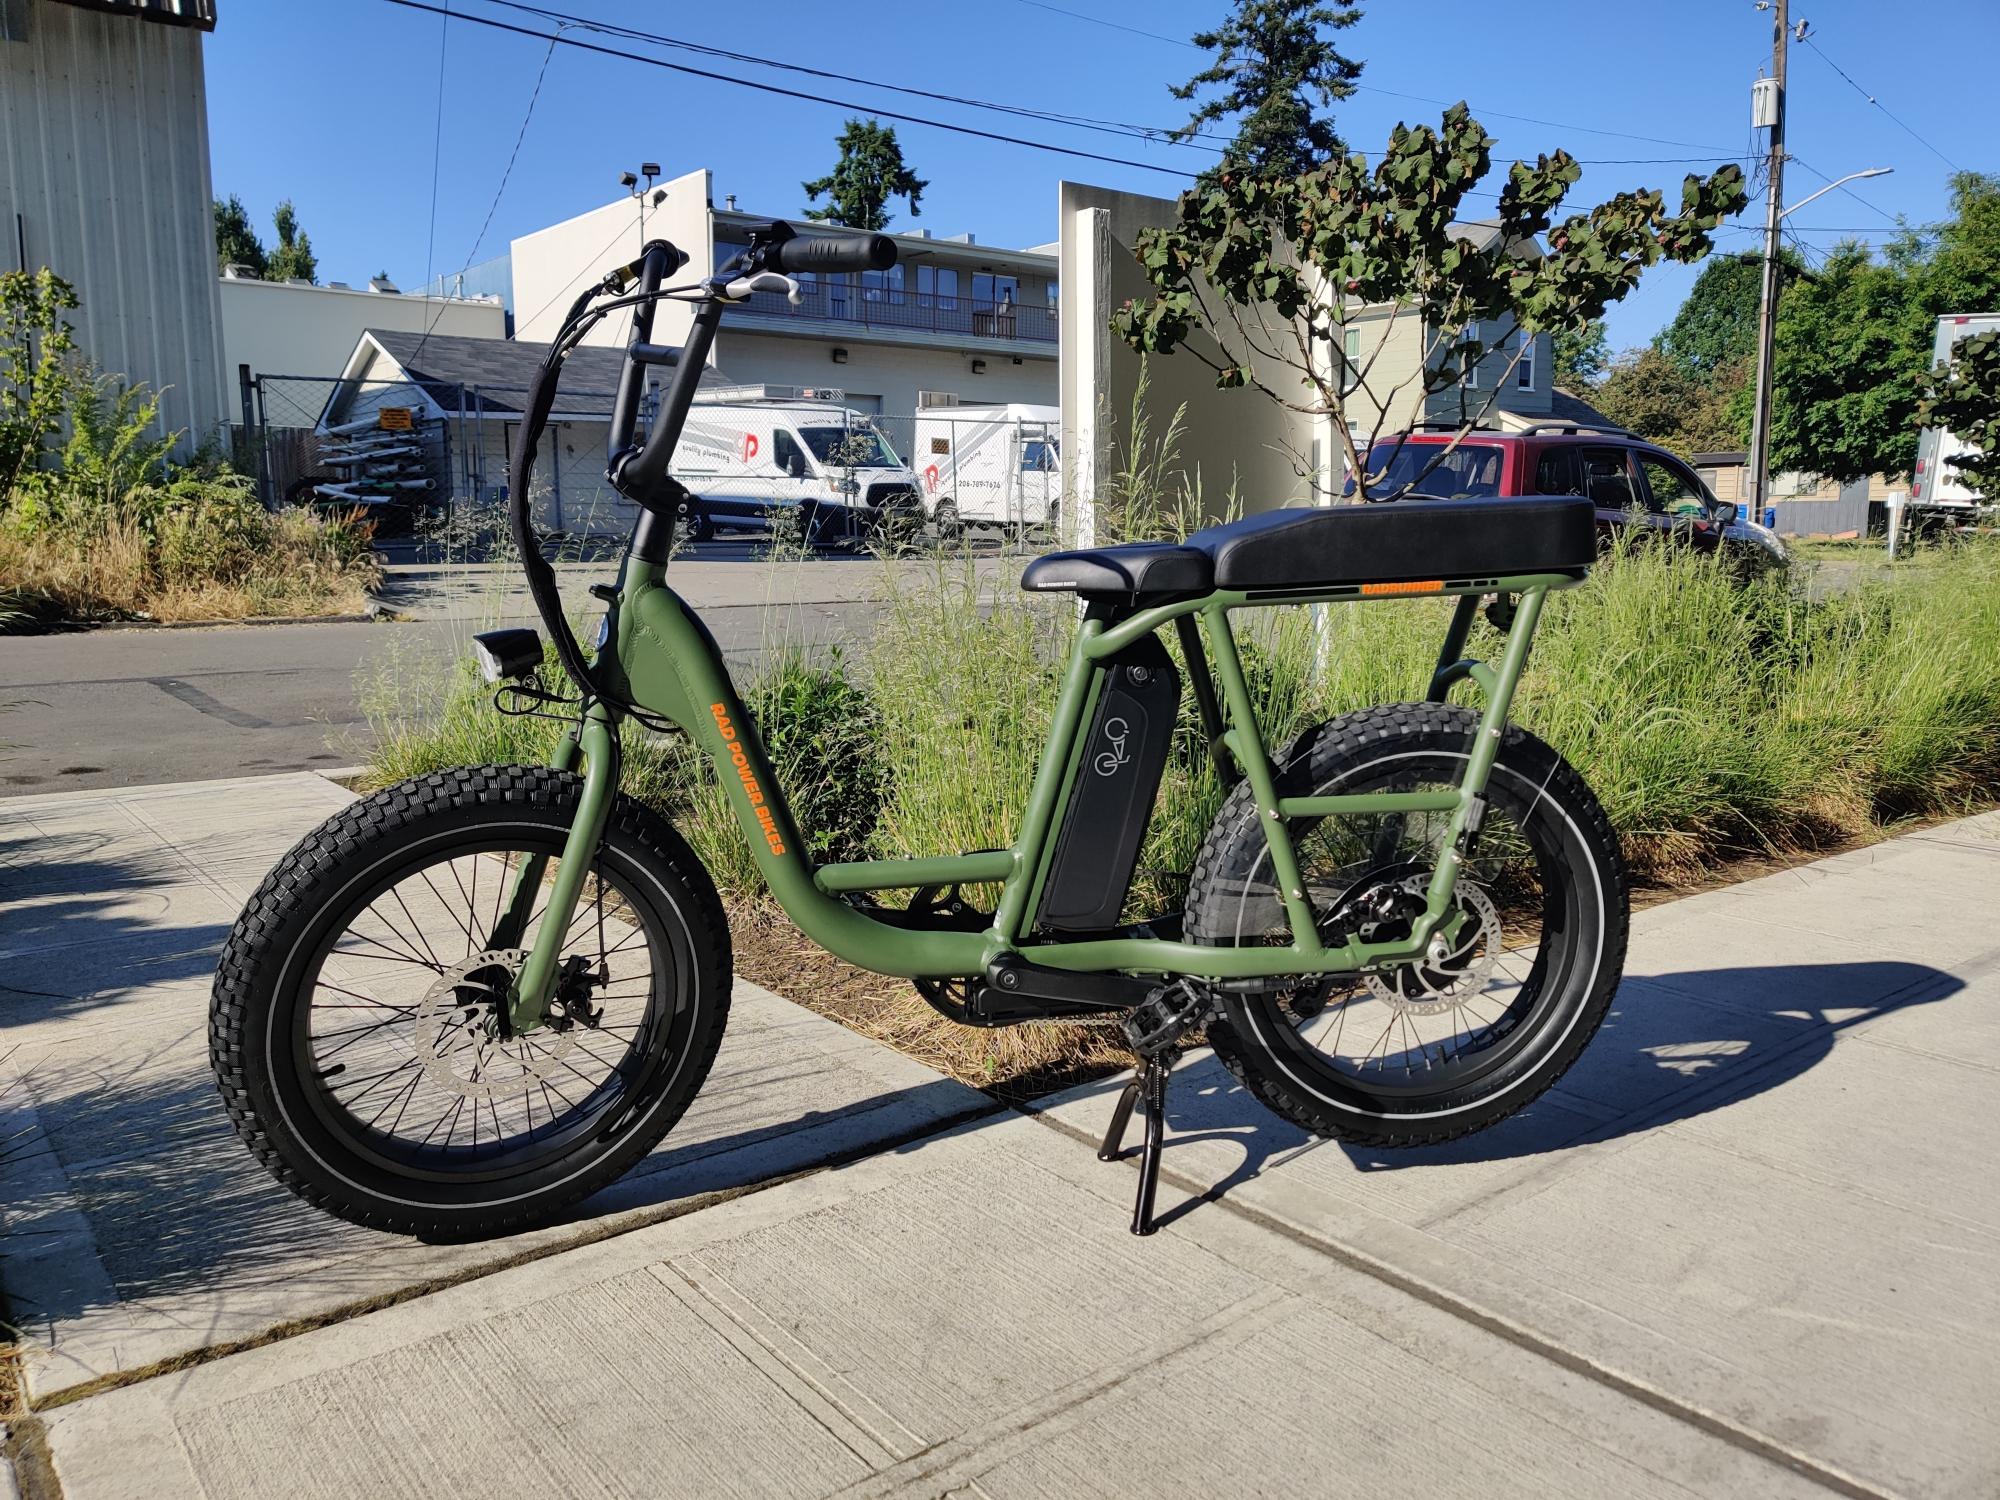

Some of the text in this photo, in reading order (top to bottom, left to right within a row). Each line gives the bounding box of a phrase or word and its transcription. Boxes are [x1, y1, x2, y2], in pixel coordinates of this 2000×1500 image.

[702, 447, 730, 464] plumbing
[710, 703, 786, 857] RAD POWER BIKES
